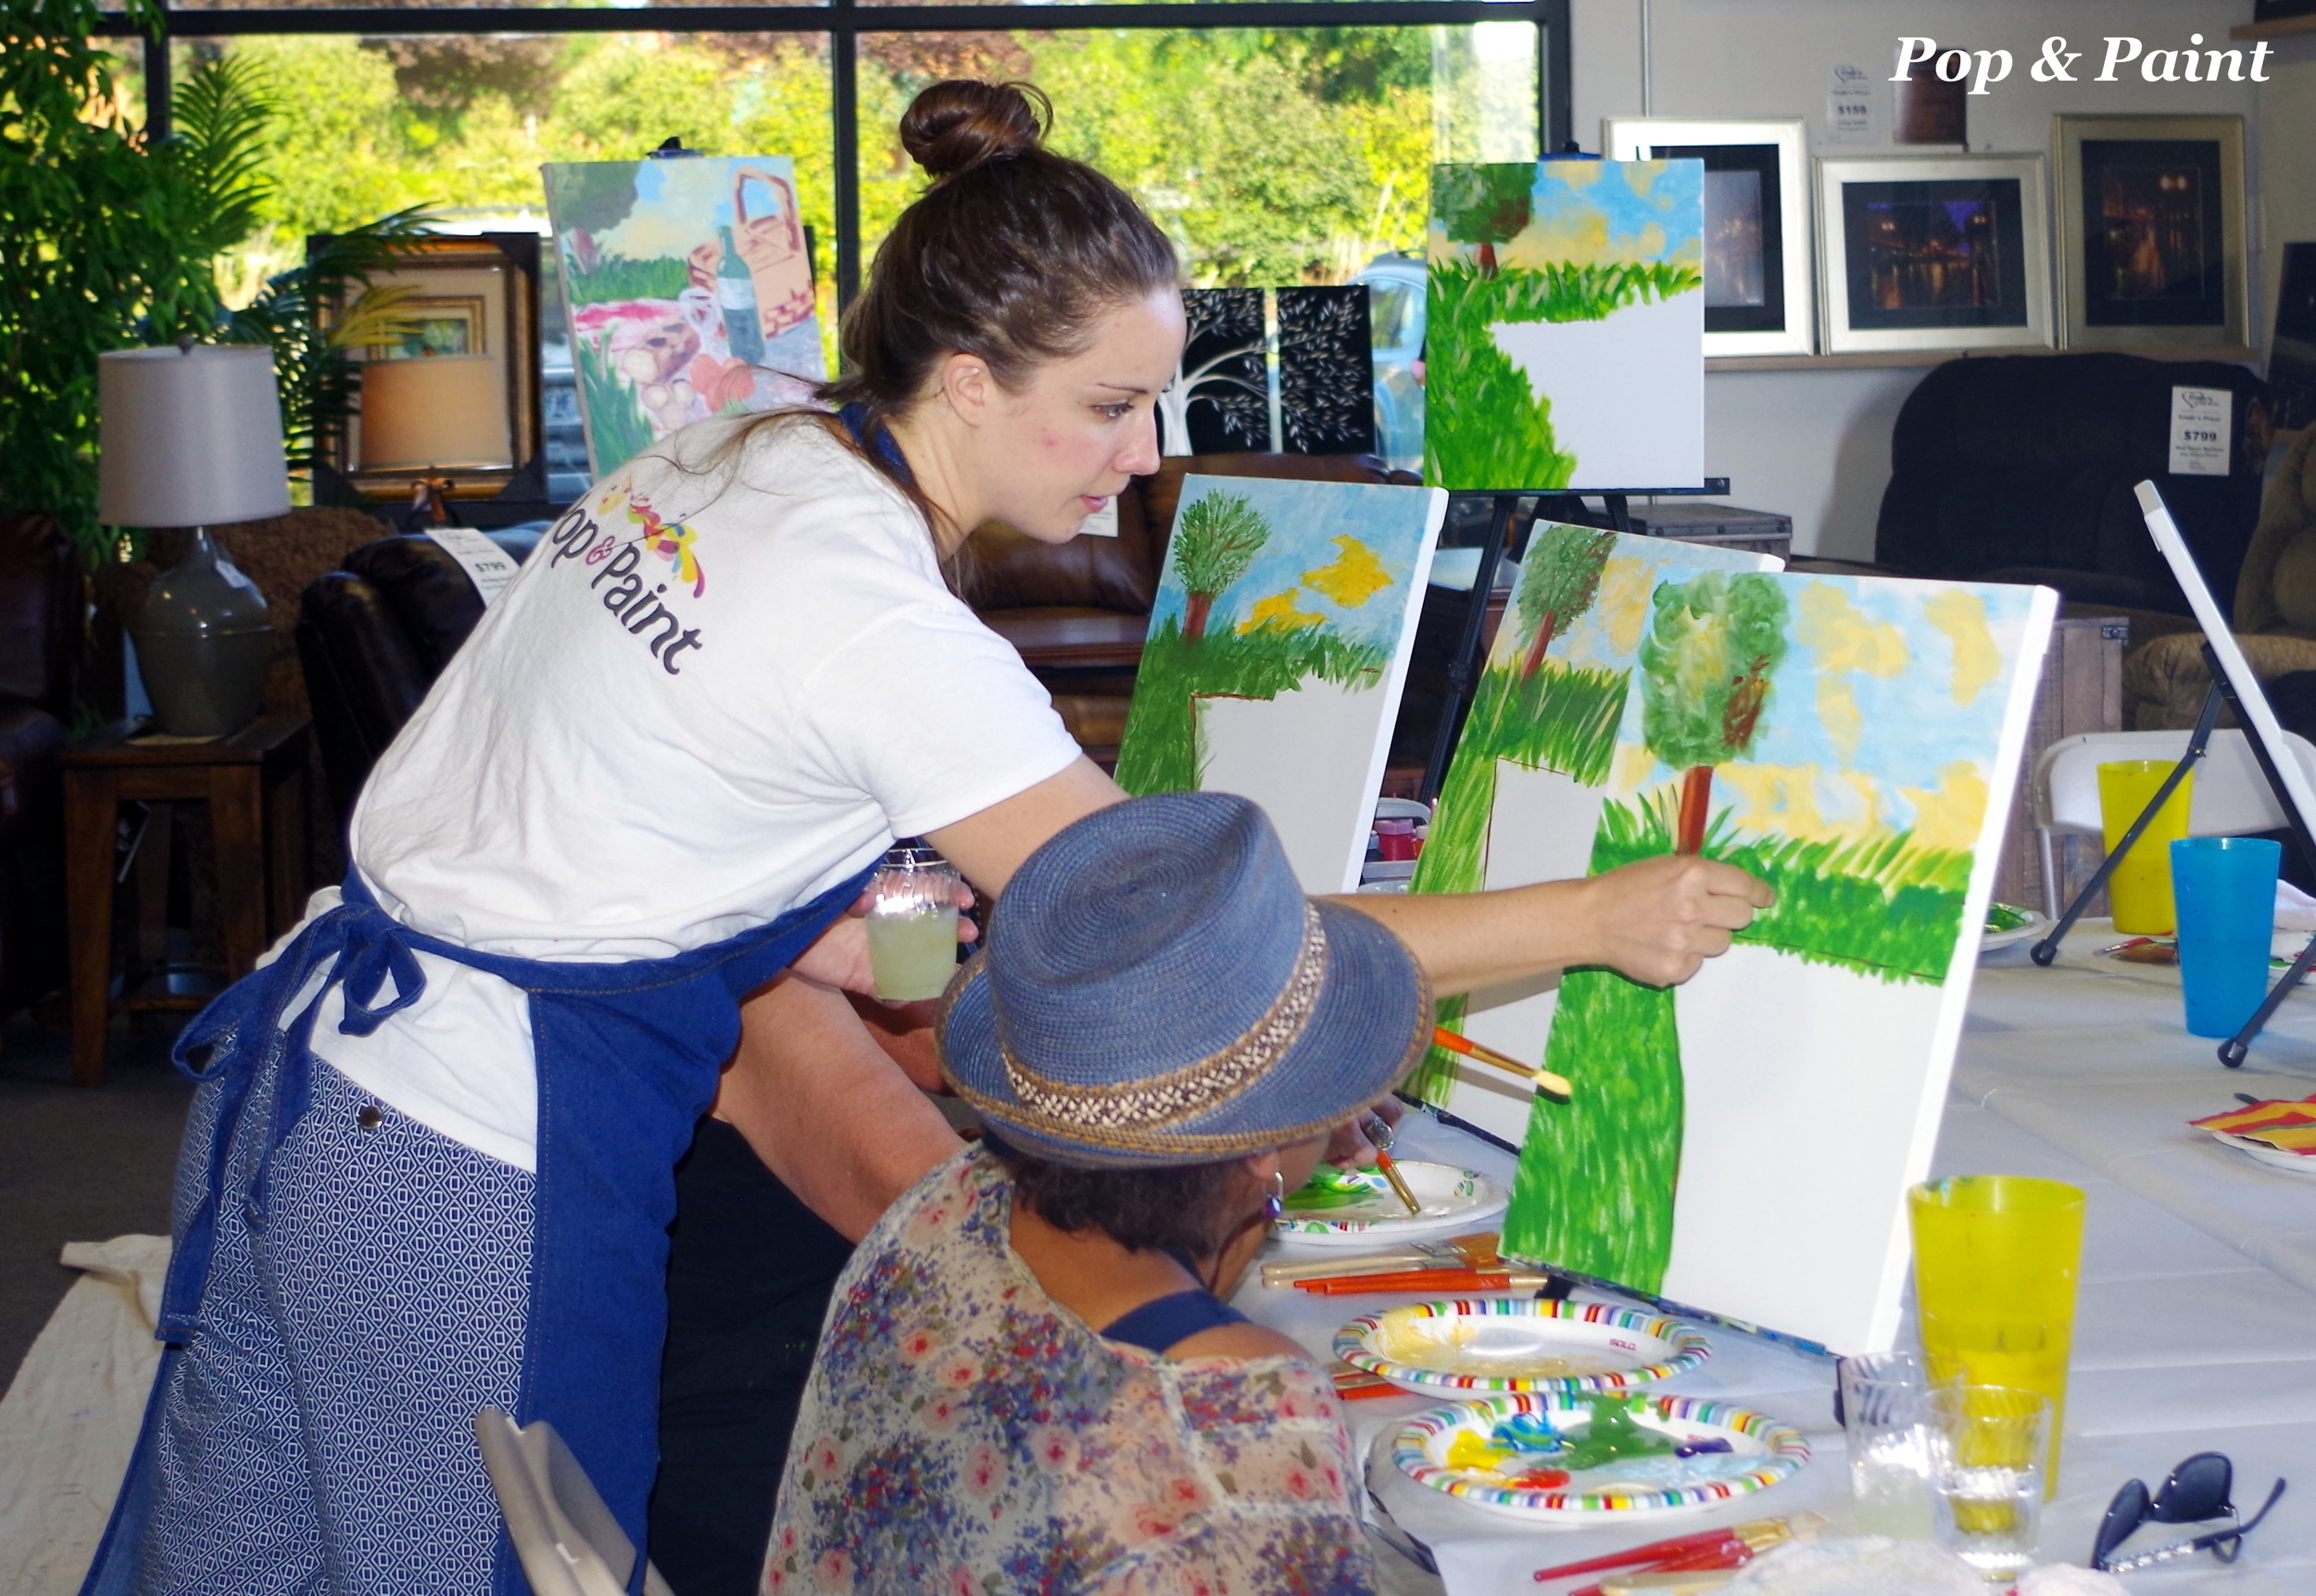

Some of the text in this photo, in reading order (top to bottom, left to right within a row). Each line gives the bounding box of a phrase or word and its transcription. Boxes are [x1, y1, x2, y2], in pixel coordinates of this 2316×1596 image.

[1837, 105, 1867, 115] $159
[2184, 431, 2217, 442] $799
[475, 561, 507, 572] $799
[550, 492, 703, 675] op & Paint
